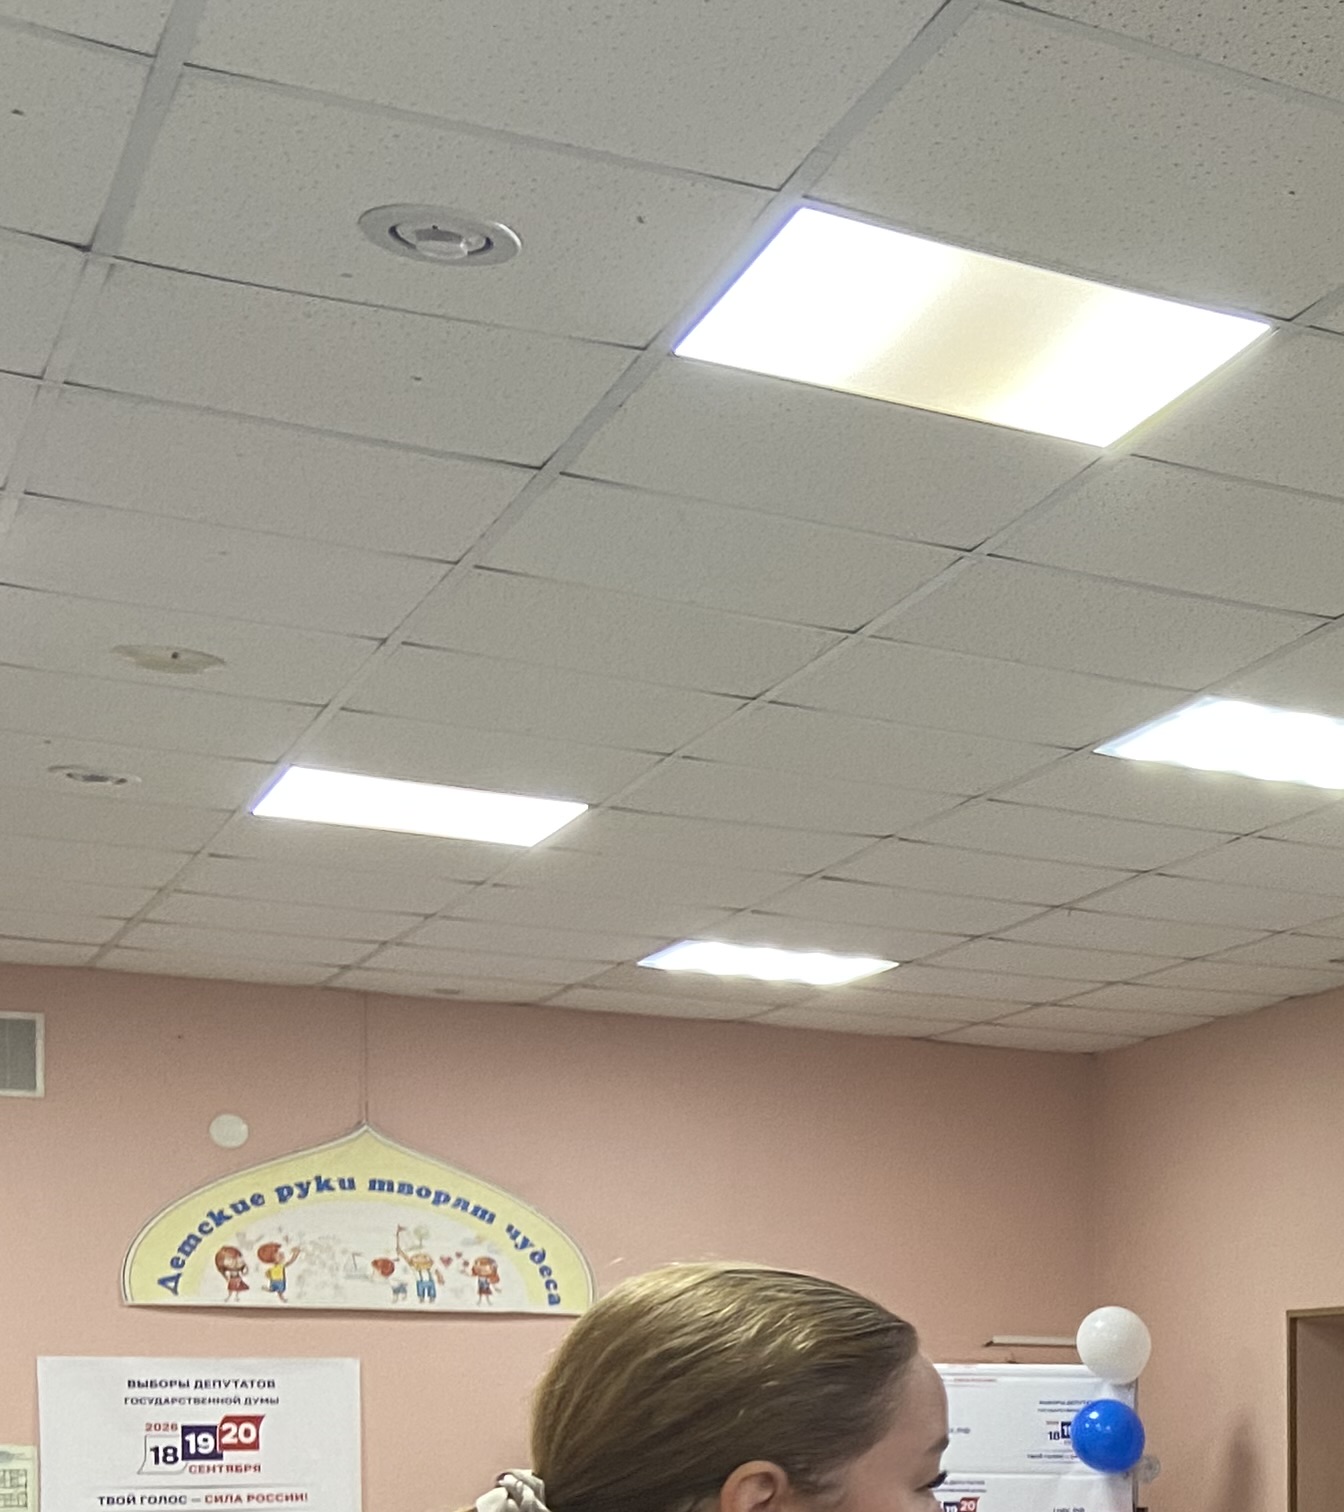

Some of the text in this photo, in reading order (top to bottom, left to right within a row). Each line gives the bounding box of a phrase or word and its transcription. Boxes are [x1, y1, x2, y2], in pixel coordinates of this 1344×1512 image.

[156, 1174, 562, 1307] Детские руки творят чудеса
[127, 1379, 276, 1390] ВЫБОРЫ ДЕПУТАТОВ
[124, 1395, 280, 1406] ГОСУДАРСТВЕННОЙ ДУМЫ
[145, 1422, 178, 1432] 2026
[150, 1422, 257, 1466] 18 19 20
[188, 1464, 262, 1475] СЕНТЯБРЯ
[98, 1494, 136, 1506] ТВОЙ
[139, 1495, 187, 1506] ГОЛОС
[204, 1494, 243, 1505] СИЛА
[247, 1492, 308, 1504] РОССИИ!
[960, 1499, 976, 1512] 20
